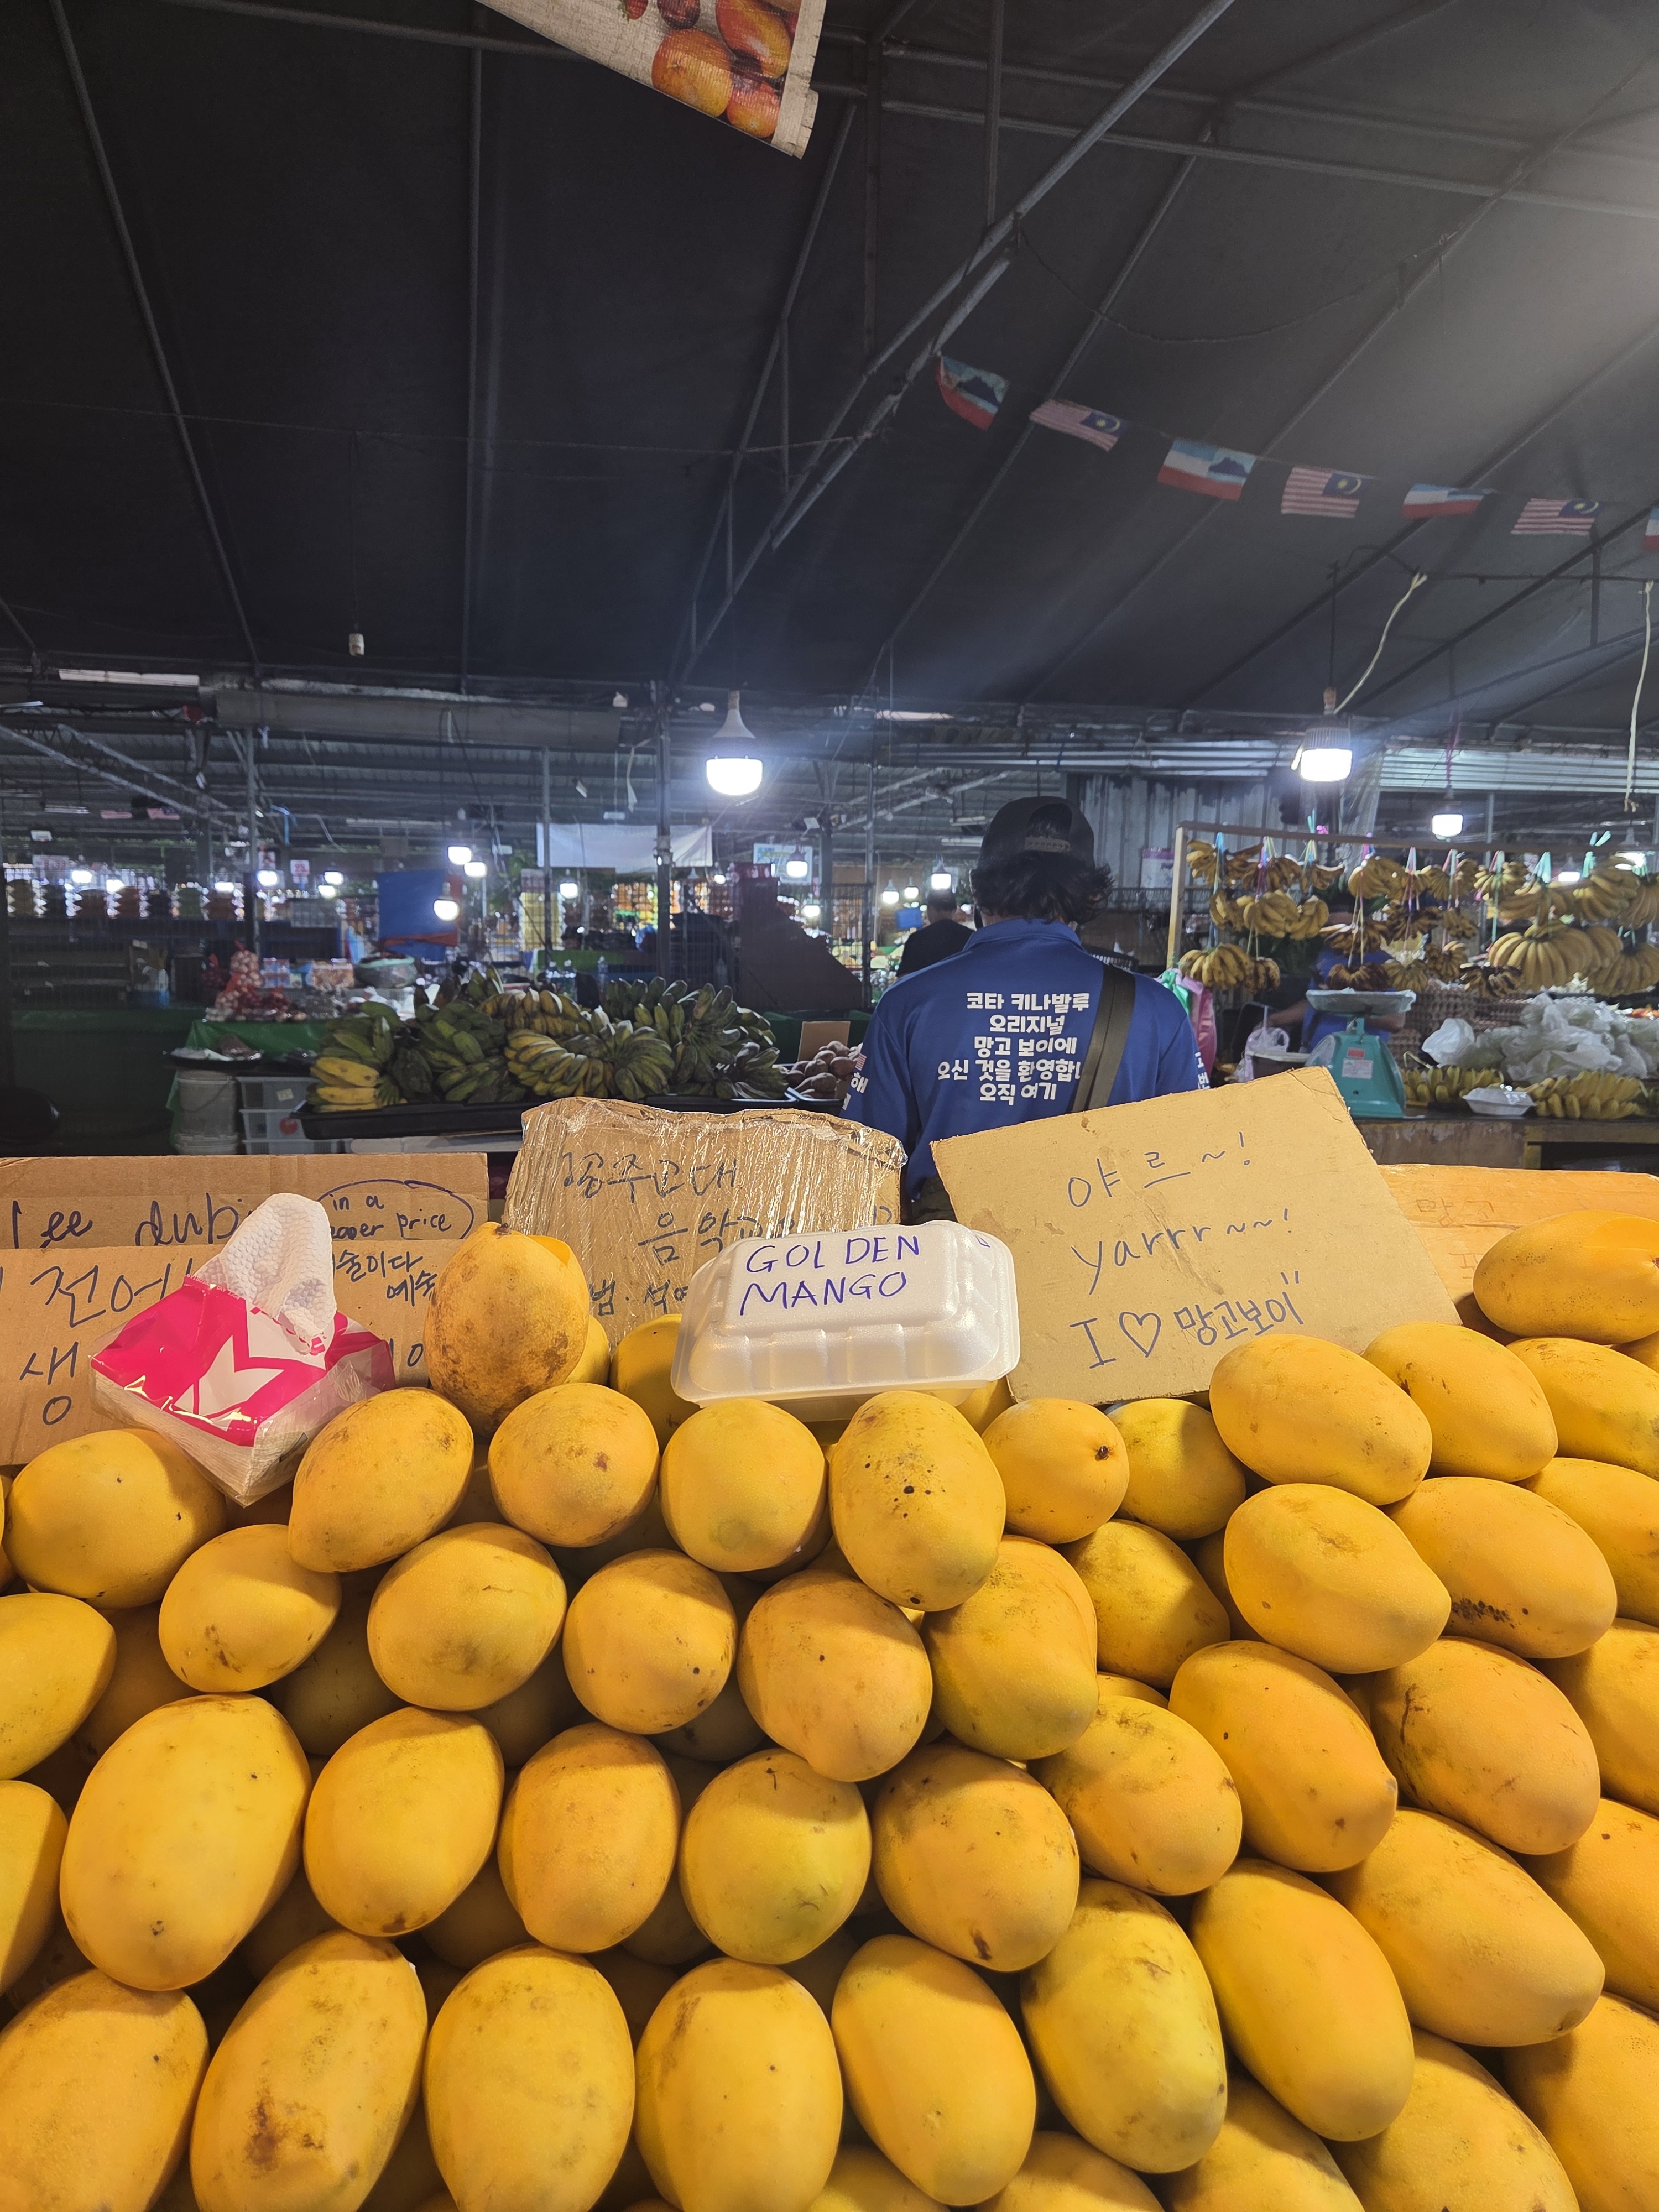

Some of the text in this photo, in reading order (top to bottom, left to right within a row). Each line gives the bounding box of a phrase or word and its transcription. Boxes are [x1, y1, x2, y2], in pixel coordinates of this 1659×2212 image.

[967, 992, 1089, 1014] 코타 키나발루
[989, 1014, 1065, 1036] 오리지널
[974, 1036, 1077, 1058] 망고 보이에
[938, 1060, 969, 1081] 오신
[975, 1059, 1011, 1082] 것을
[980, 1082, 1057, 1105] 오직 여기
[366, 1195, 385, 1210] a
[395, 1208, 452, 1240] price
[332, 1249, 424, 1282] 술이다
[739, 1271, 907, 1316] MANGO
